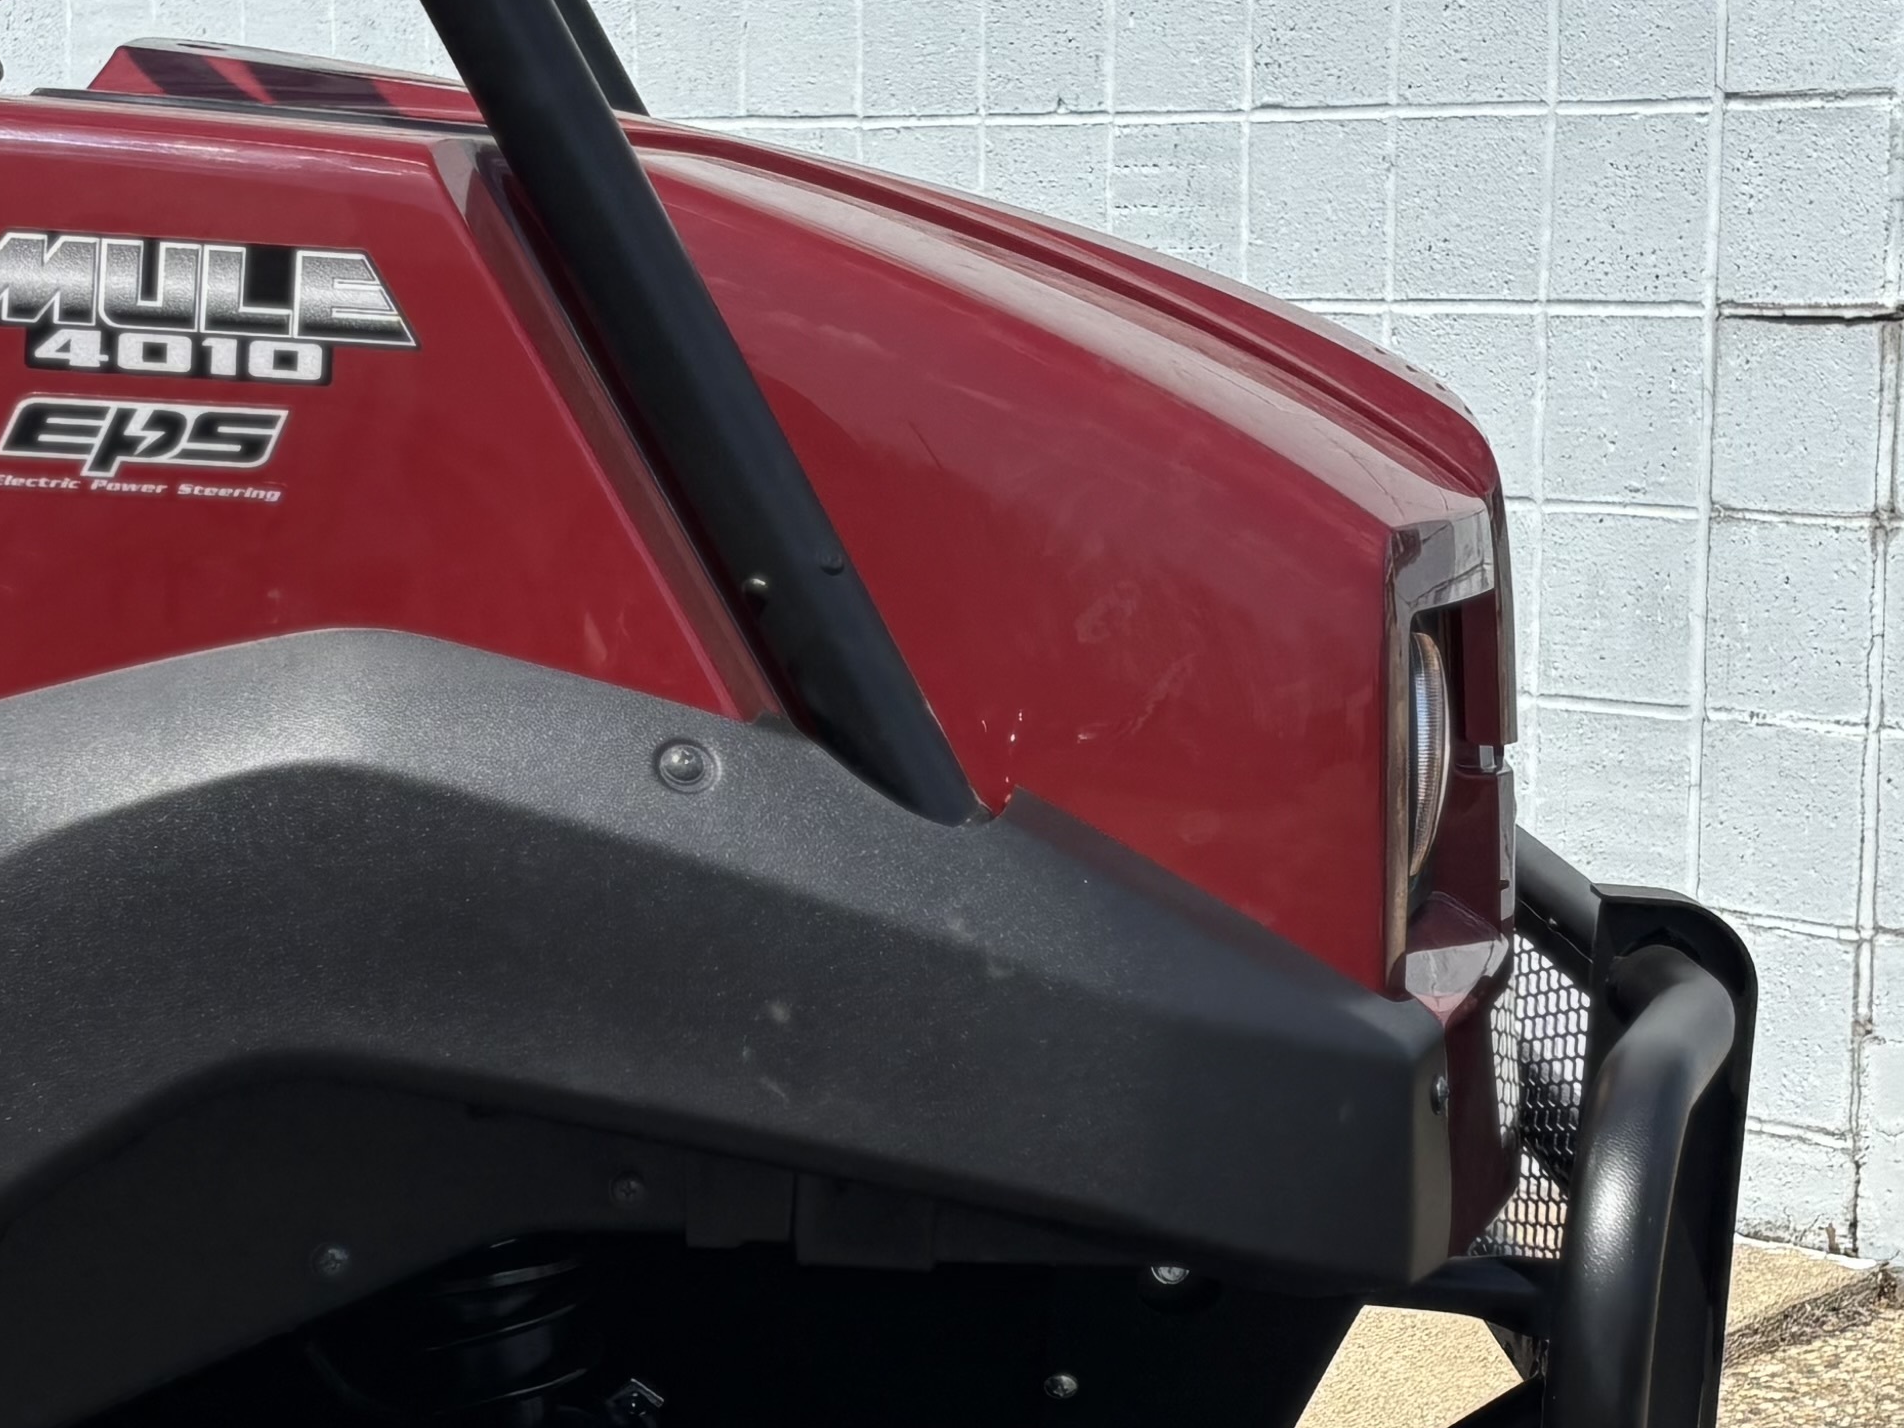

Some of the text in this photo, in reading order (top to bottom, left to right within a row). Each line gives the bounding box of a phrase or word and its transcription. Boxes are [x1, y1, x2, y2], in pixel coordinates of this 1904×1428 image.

[33, 327, 327, 382] 4010
[90, 478, 169, 497] Power
[177, 482, 284, 504] Steering
